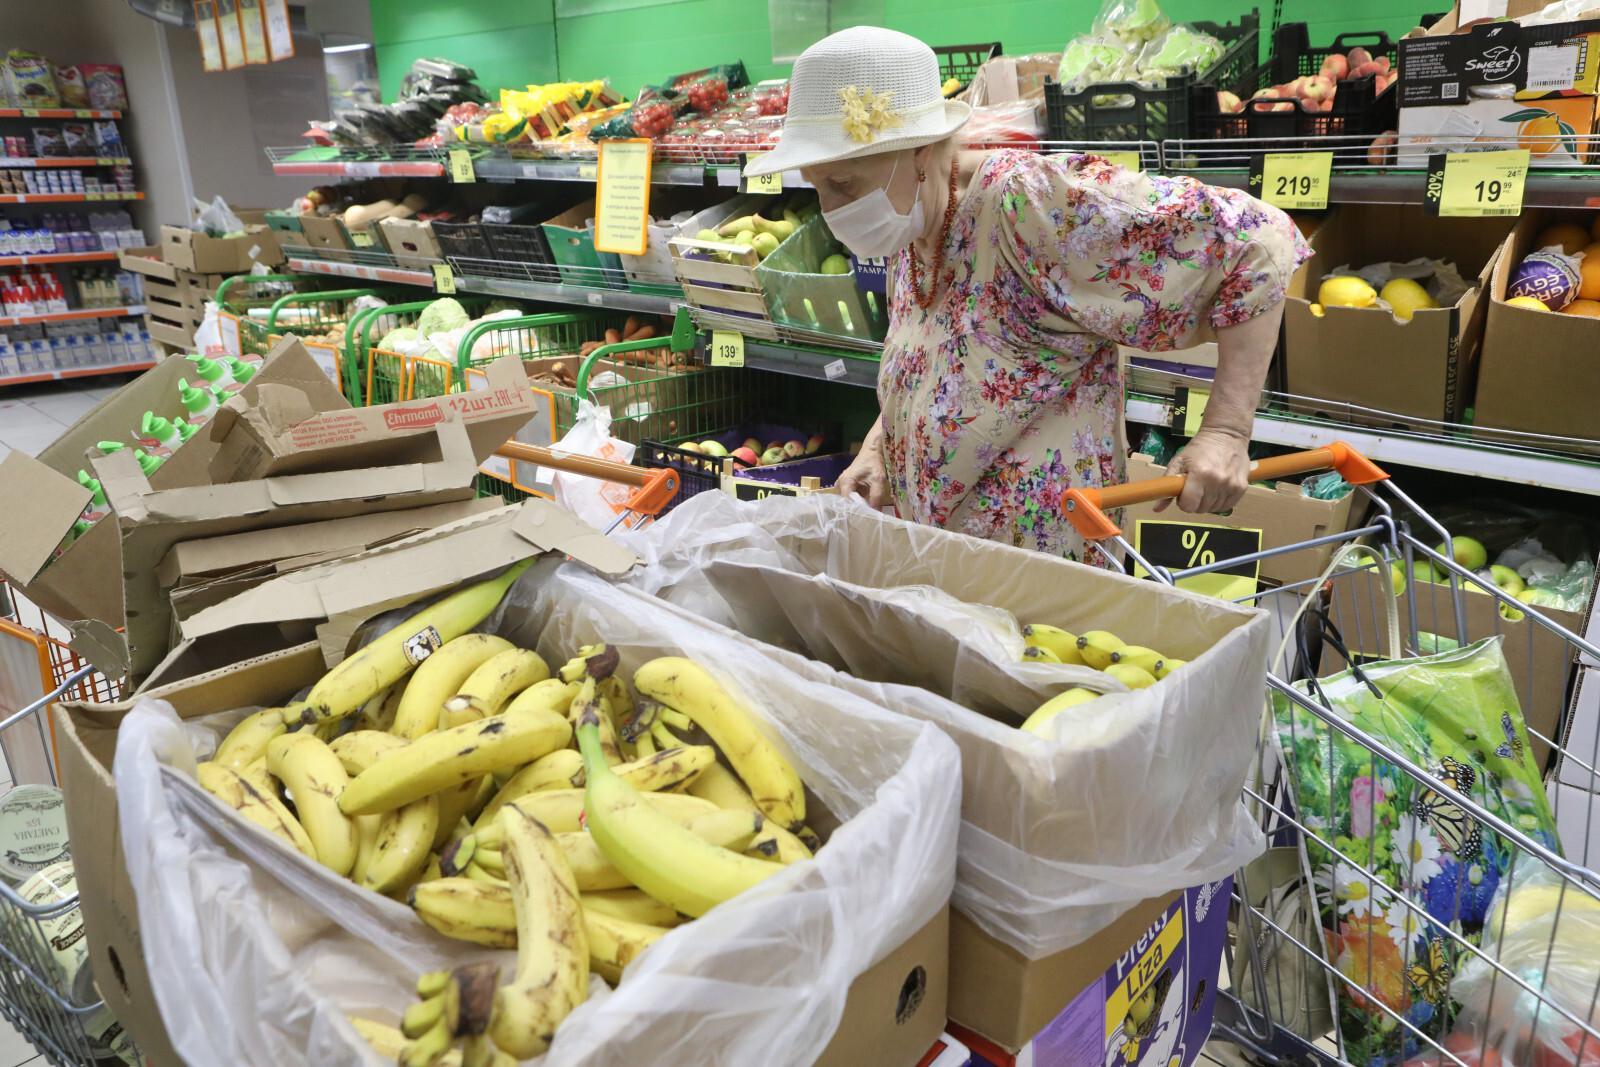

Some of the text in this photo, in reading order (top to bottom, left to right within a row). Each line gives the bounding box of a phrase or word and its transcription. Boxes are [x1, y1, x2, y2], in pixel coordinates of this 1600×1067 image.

[1464, 54, 1515, 71] Sweet
[1275, 176, 1311, 196] 219
[1426, 170, 1444, 202] -20%
[1474, 180, 1502, 203] 19
[719, 344, 736, 358] 139
[387, 408, 441, 426] Ehrmann
[1174, 405, 1186, 416] %
[1181, 529, 1216, 568] %
[1126, 943, 1163, 1003] Liza
